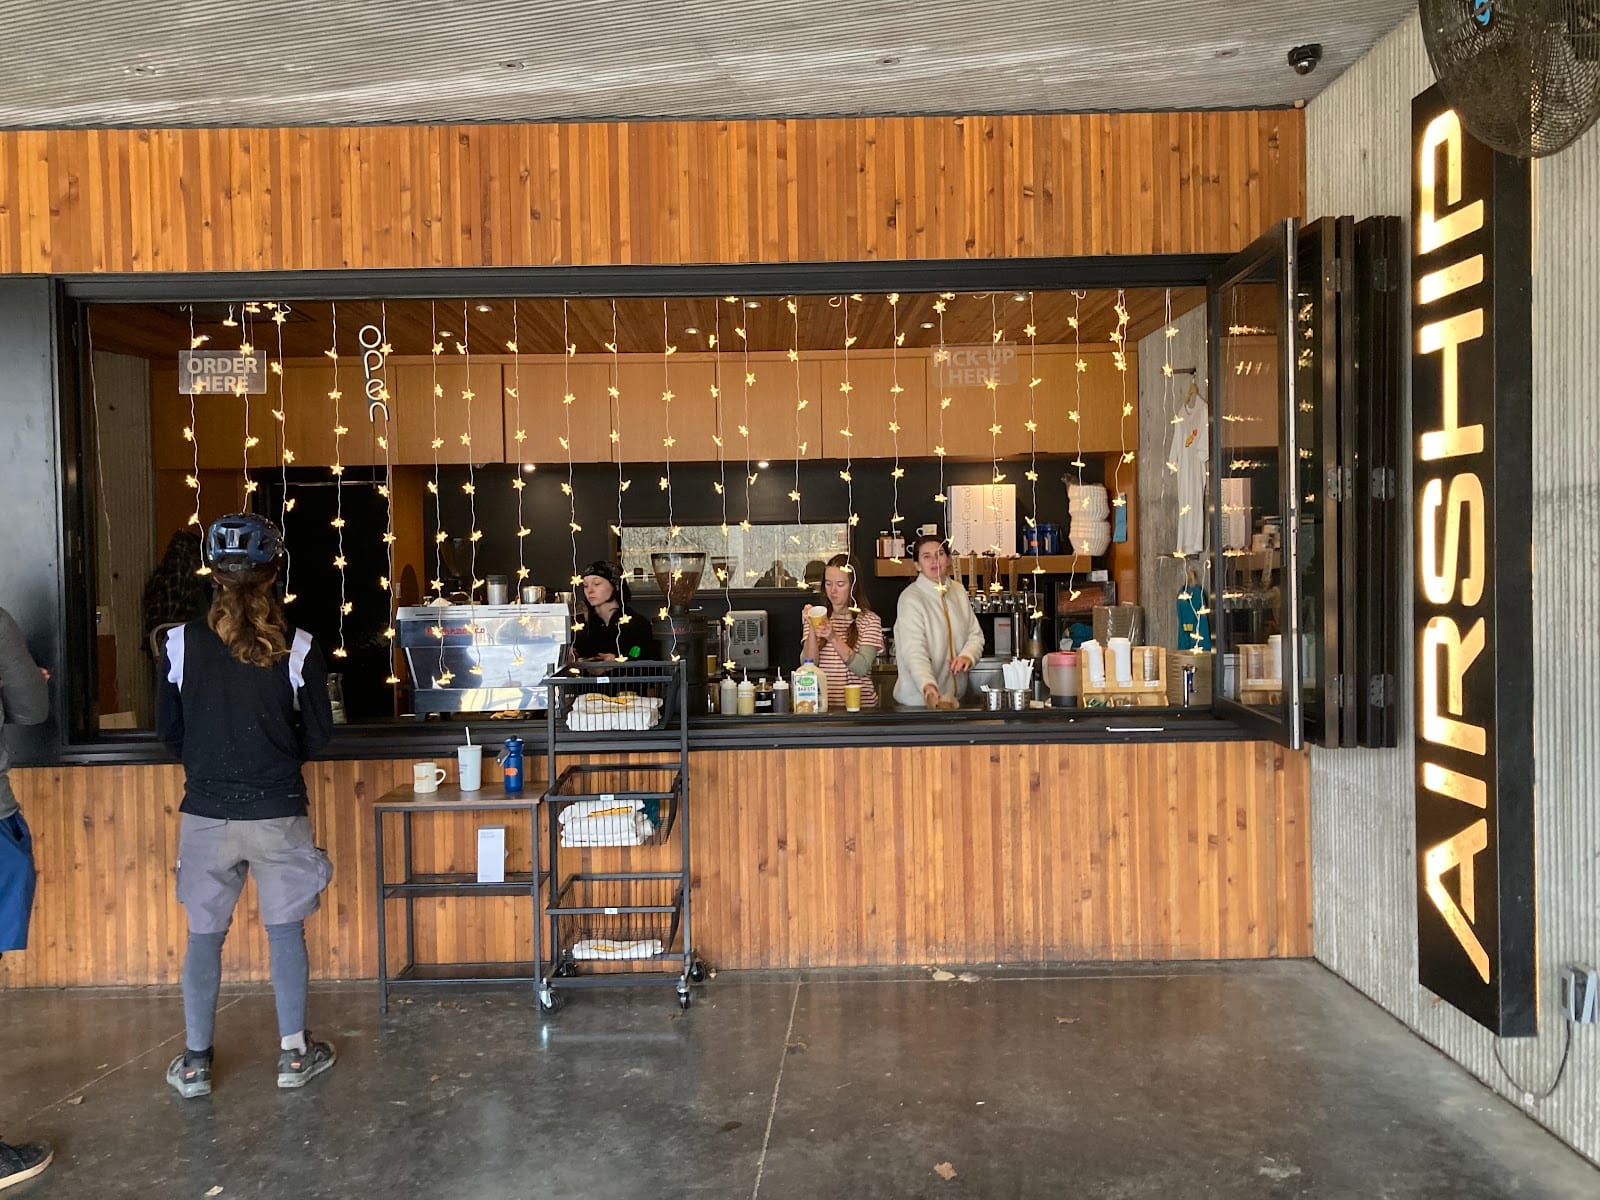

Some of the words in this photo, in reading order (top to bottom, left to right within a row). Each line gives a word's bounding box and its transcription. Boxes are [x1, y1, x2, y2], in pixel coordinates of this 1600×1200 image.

[186, 357, 258, 374] ORDER
[933, 348, 1015, 368] PICK-UP
[359, 325, 389, 422] open
[949, 368, 1001, 386] HERE
[195, 375, 249, 393] HERE
[1419, 109, 1490, 985] AIRSHIP
